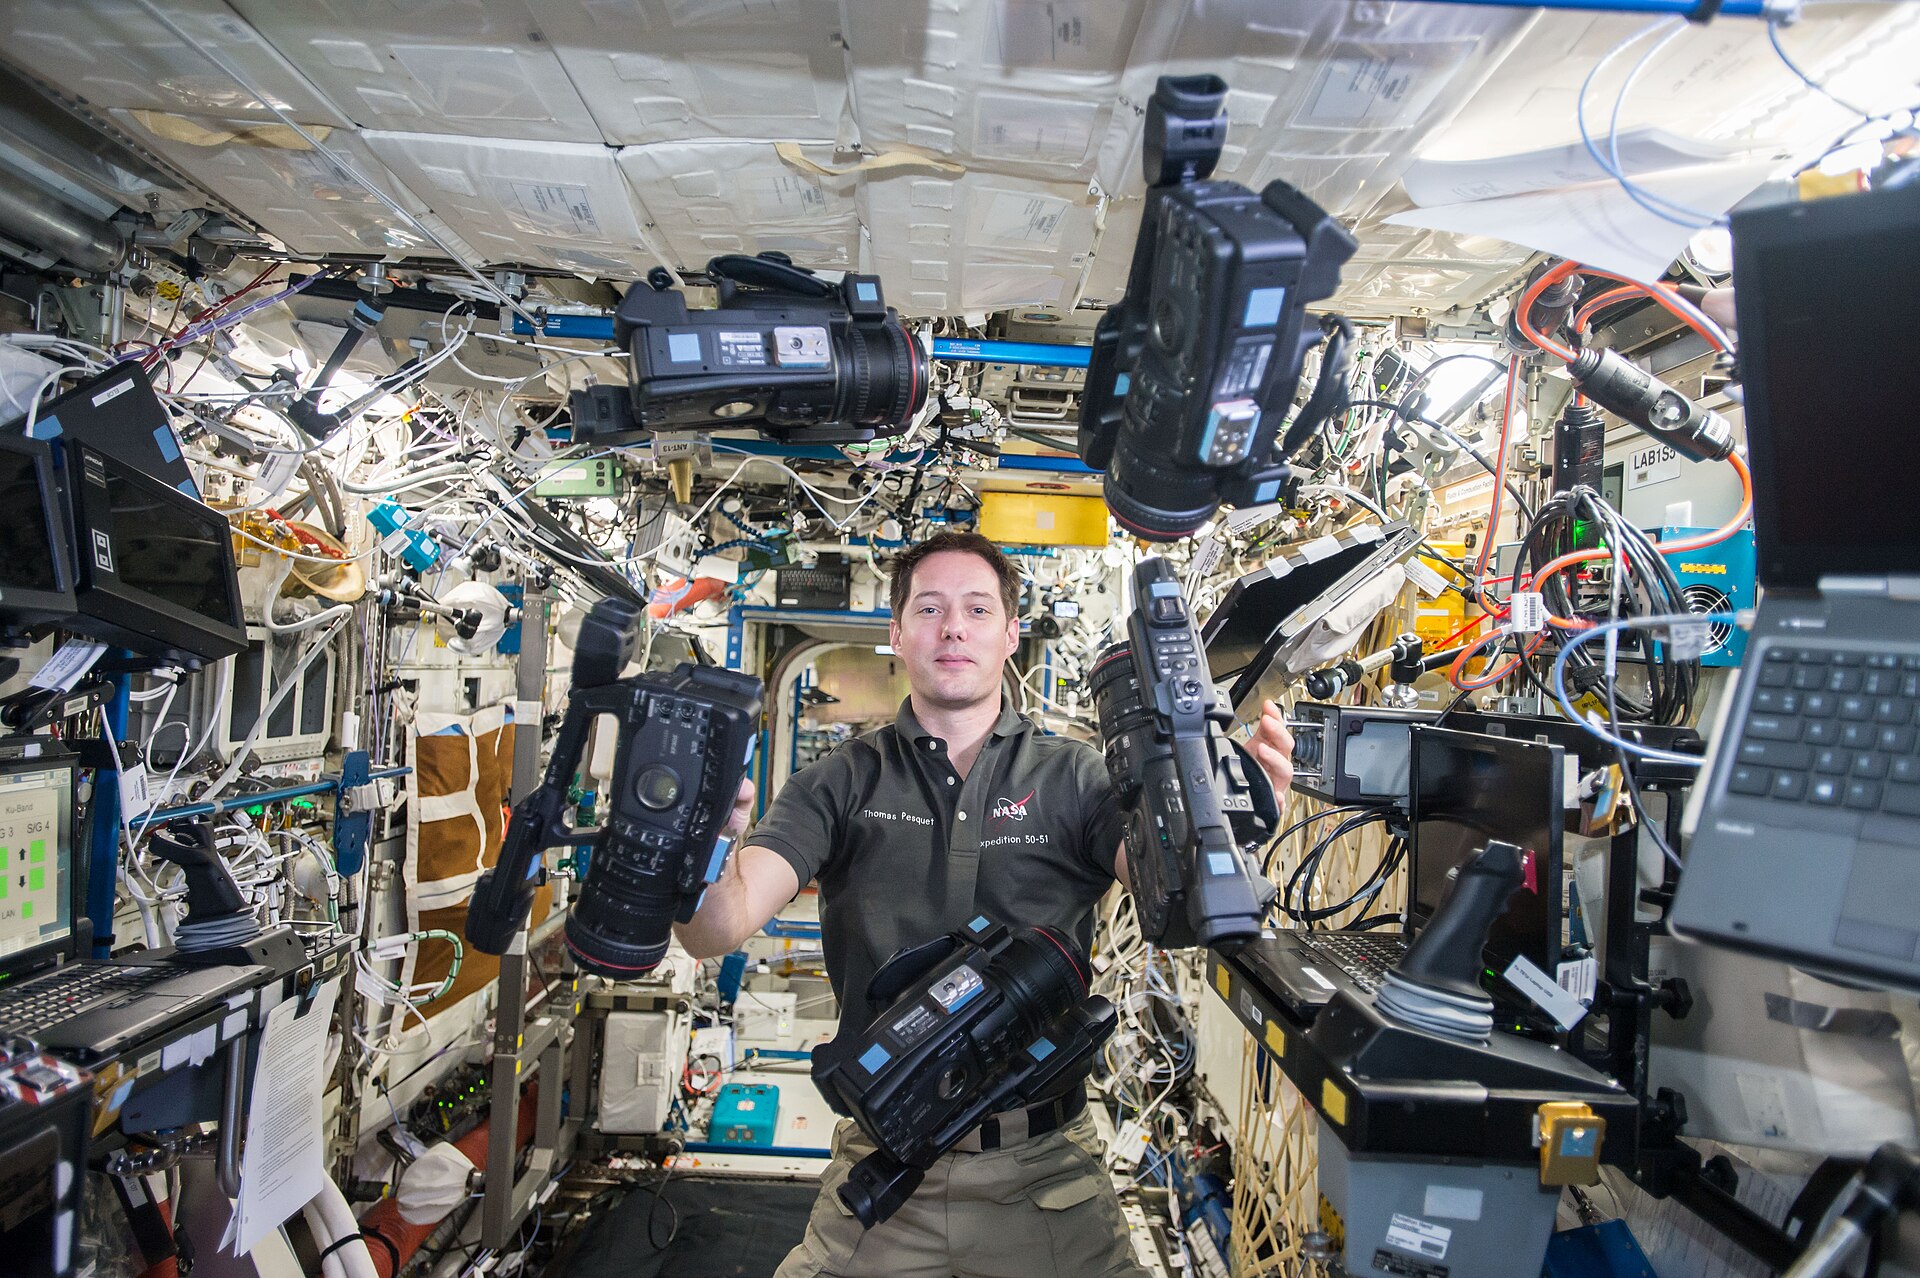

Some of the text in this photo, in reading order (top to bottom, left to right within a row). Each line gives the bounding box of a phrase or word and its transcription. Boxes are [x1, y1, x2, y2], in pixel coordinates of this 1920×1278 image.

[663, 443, 688, 452] ANT-13
[5, 803, 33, 815] Ku-Band
[993, 805, 1028, 818] NASA
[863, 809, 933, 826] Thomas Pesquet
[8, 827, 14, 838] 3
[26, 820, 50, 834] S/G 4
[980, 834, 1049, 848] xpedition 50-51
[1, 910, 16, 919] LAN
